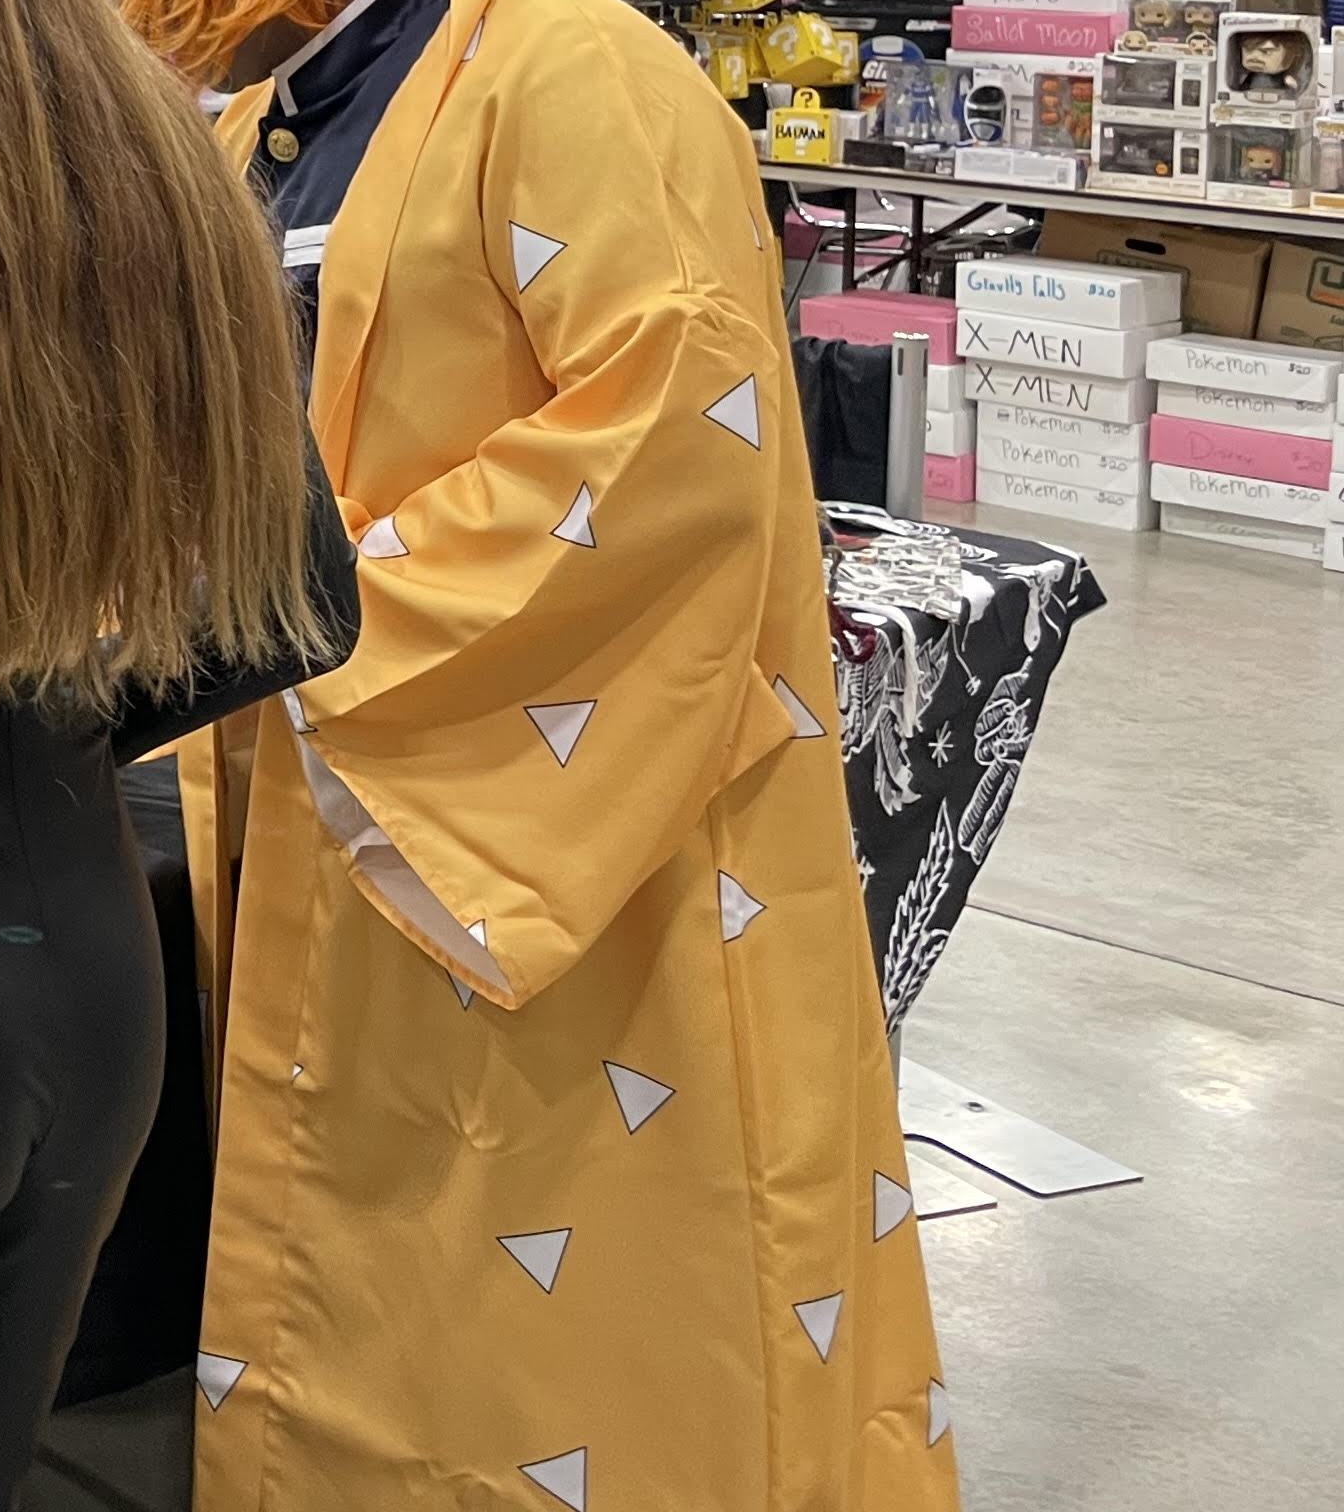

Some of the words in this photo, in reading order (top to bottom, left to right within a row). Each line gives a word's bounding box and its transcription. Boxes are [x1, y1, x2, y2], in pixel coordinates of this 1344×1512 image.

[967, 14, 1030, 45] Sailor
[1033, 275, 1066, 301] Falls
[1088, 283, 1116, 299] $20
[964, 318, 1082, 367] X-MEN
[1186, 349, 1268, 376] Pokemon
[975, 363, 1093, 411] X-MEN
[1195, 388, 1275, 413] Pokemon
[1014, 407, 1082, 435] Pokemon
[1002, 438, 1080, 469] Pokemon
[1004, 474, 1079, 503] Pokemon
[1189, 472, 1271, 499] Pokemon
